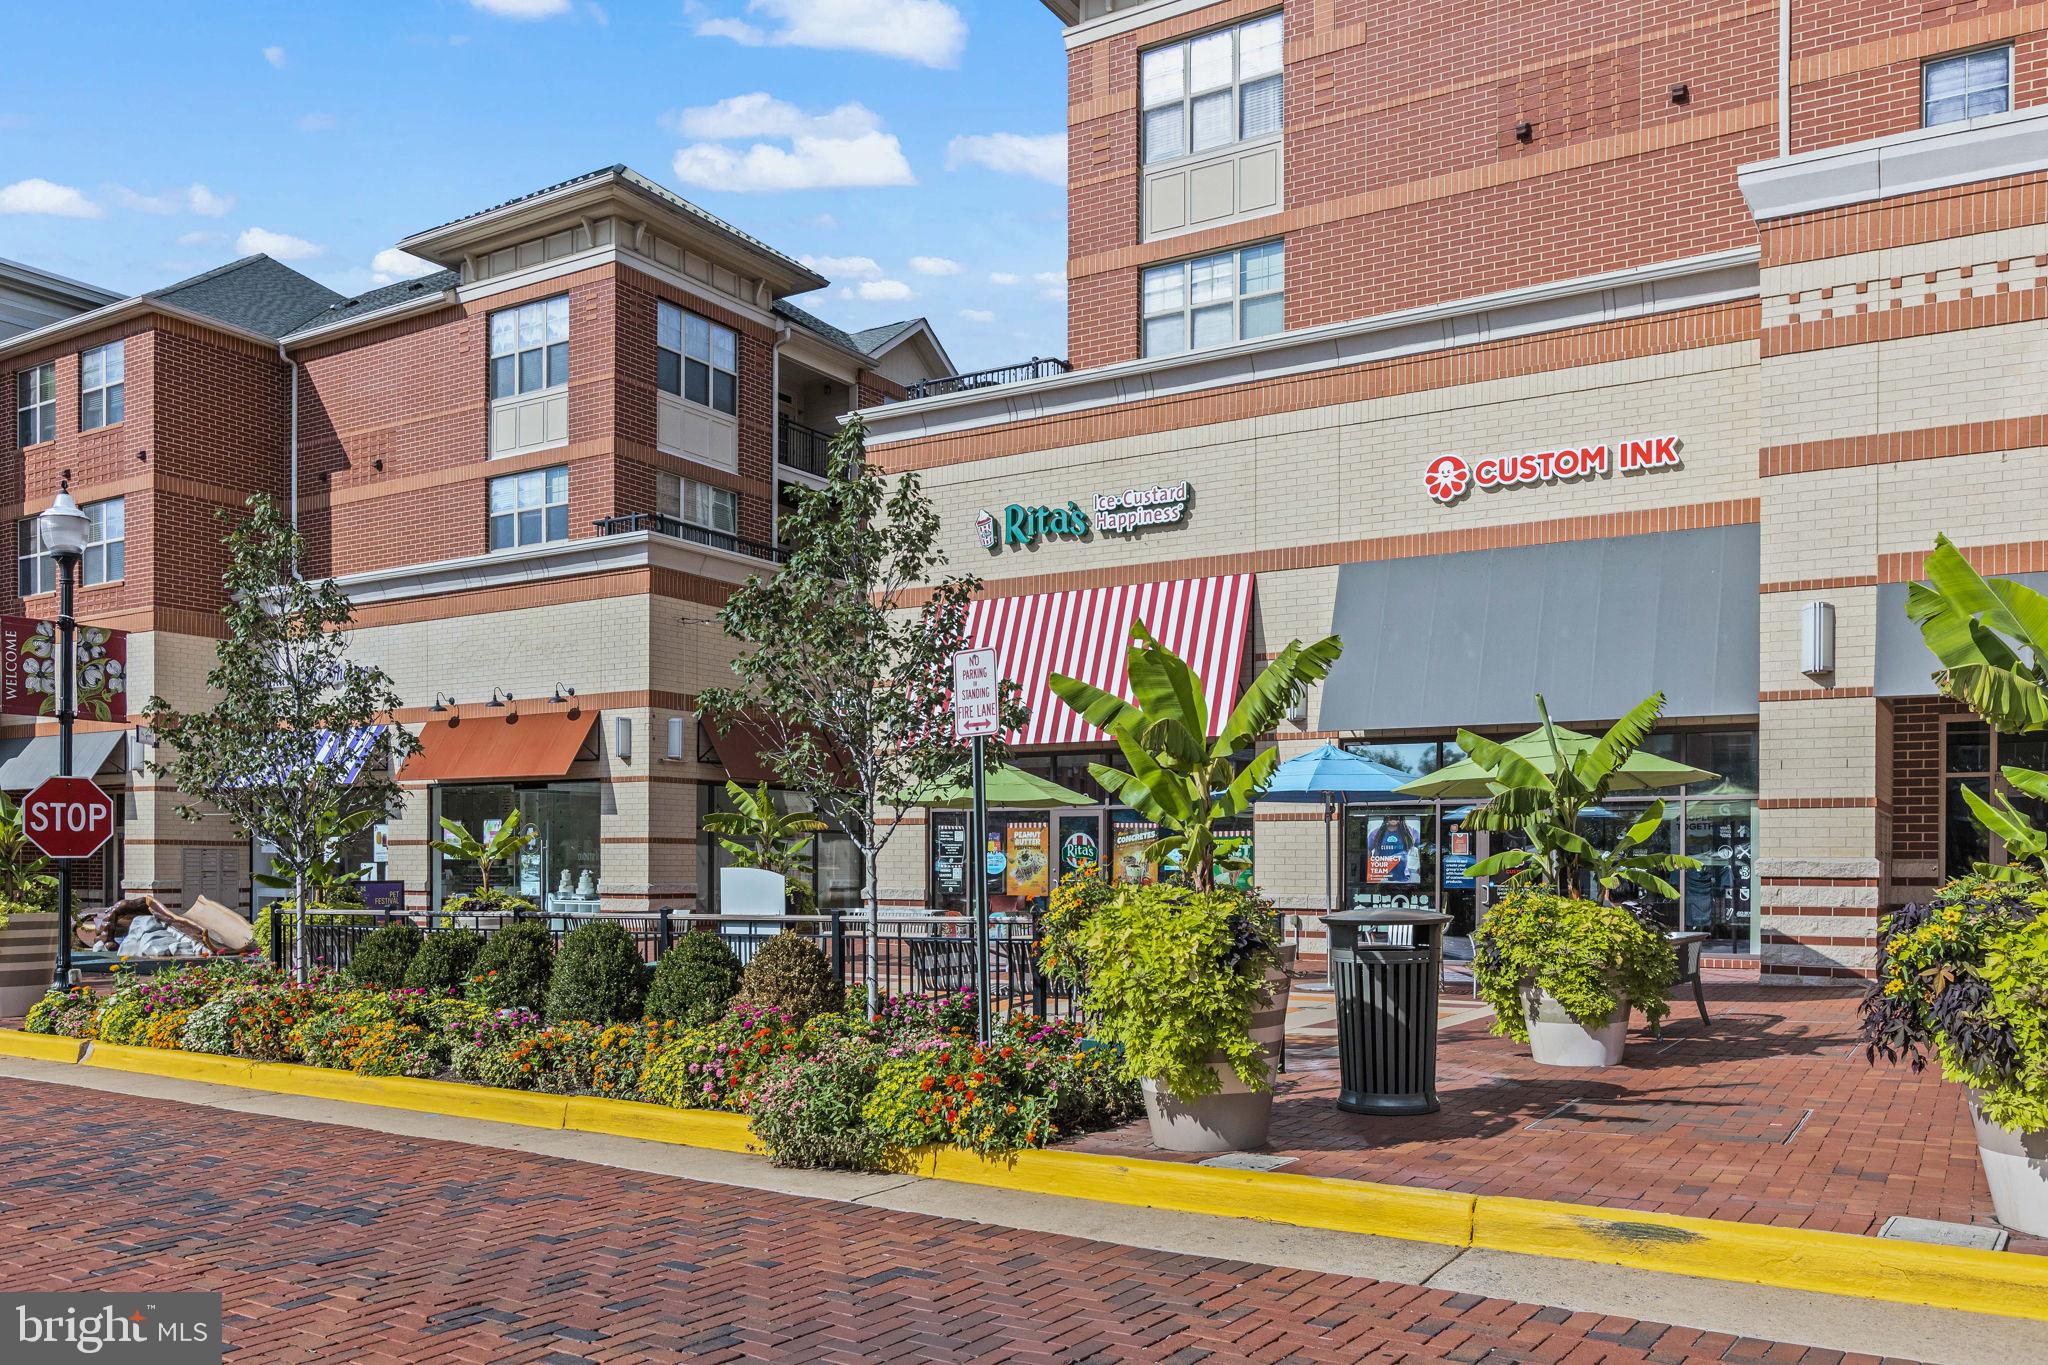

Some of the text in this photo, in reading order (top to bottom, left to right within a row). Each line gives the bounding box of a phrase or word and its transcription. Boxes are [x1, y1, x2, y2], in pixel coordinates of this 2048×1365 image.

[1476, 436, 1678, 486] CUSTOM INK
[1005, 501, 1087, 544] Rita's
[6, 630, 17, 700] WELCOME
[969, 655, 980, 667] NO
[963, 667, 987, 680] PARKING
[962, 687, 989, 700] STANDING
[958, 703, 996, 719] FIRE LANE
[30, 802, 107, 832] STOP
[1067, 844, 1094, 857] Rita's
